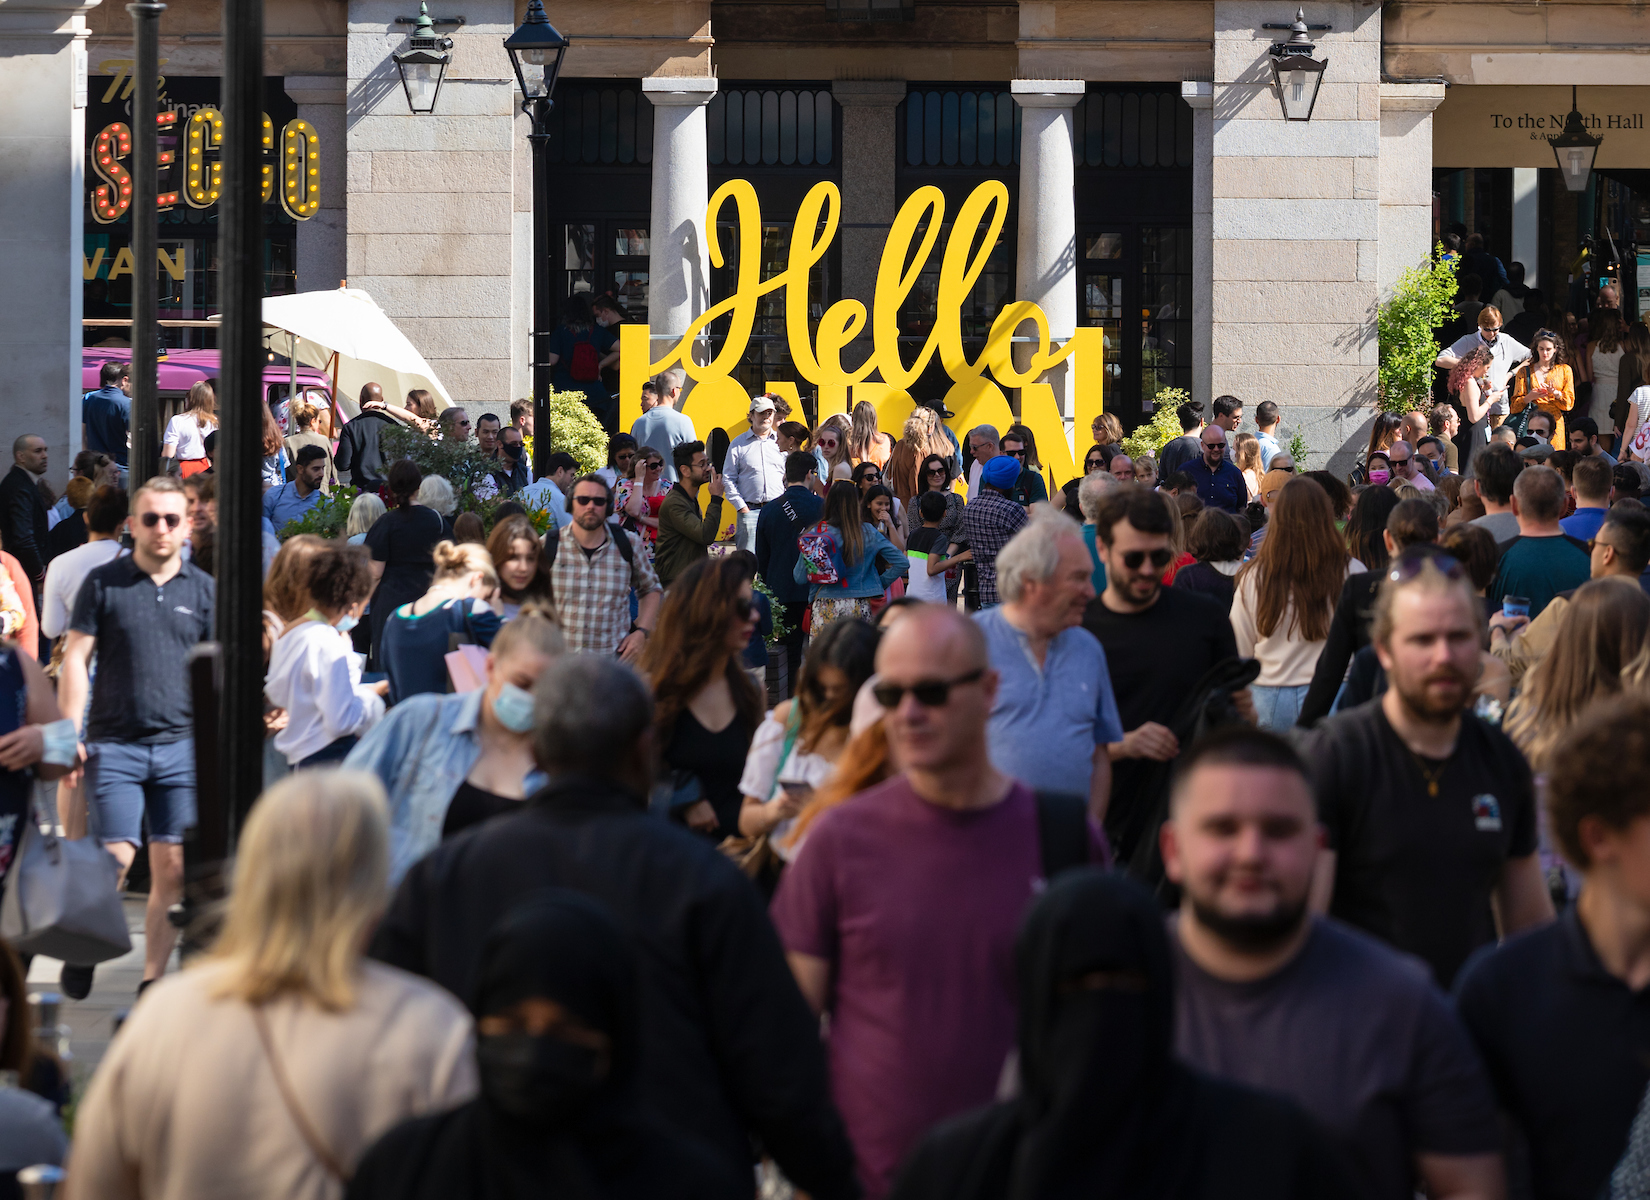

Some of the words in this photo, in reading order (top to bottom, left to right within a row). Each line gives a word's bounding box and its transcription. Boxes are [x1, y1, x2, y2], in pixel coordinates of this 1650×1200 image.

[1490, 114, 1513, 129] To
[1517, 113, 1545, 129] the
[1549, 113, 1602, 129] Nth
[1606, 113, 1644, 129] Hall
[1529, 131, 1538, 140] &
[83, 247, 185, 281] VAN
[649, 179, 1076, 390] Hello
[782, 500, 799, 522] VLTN
